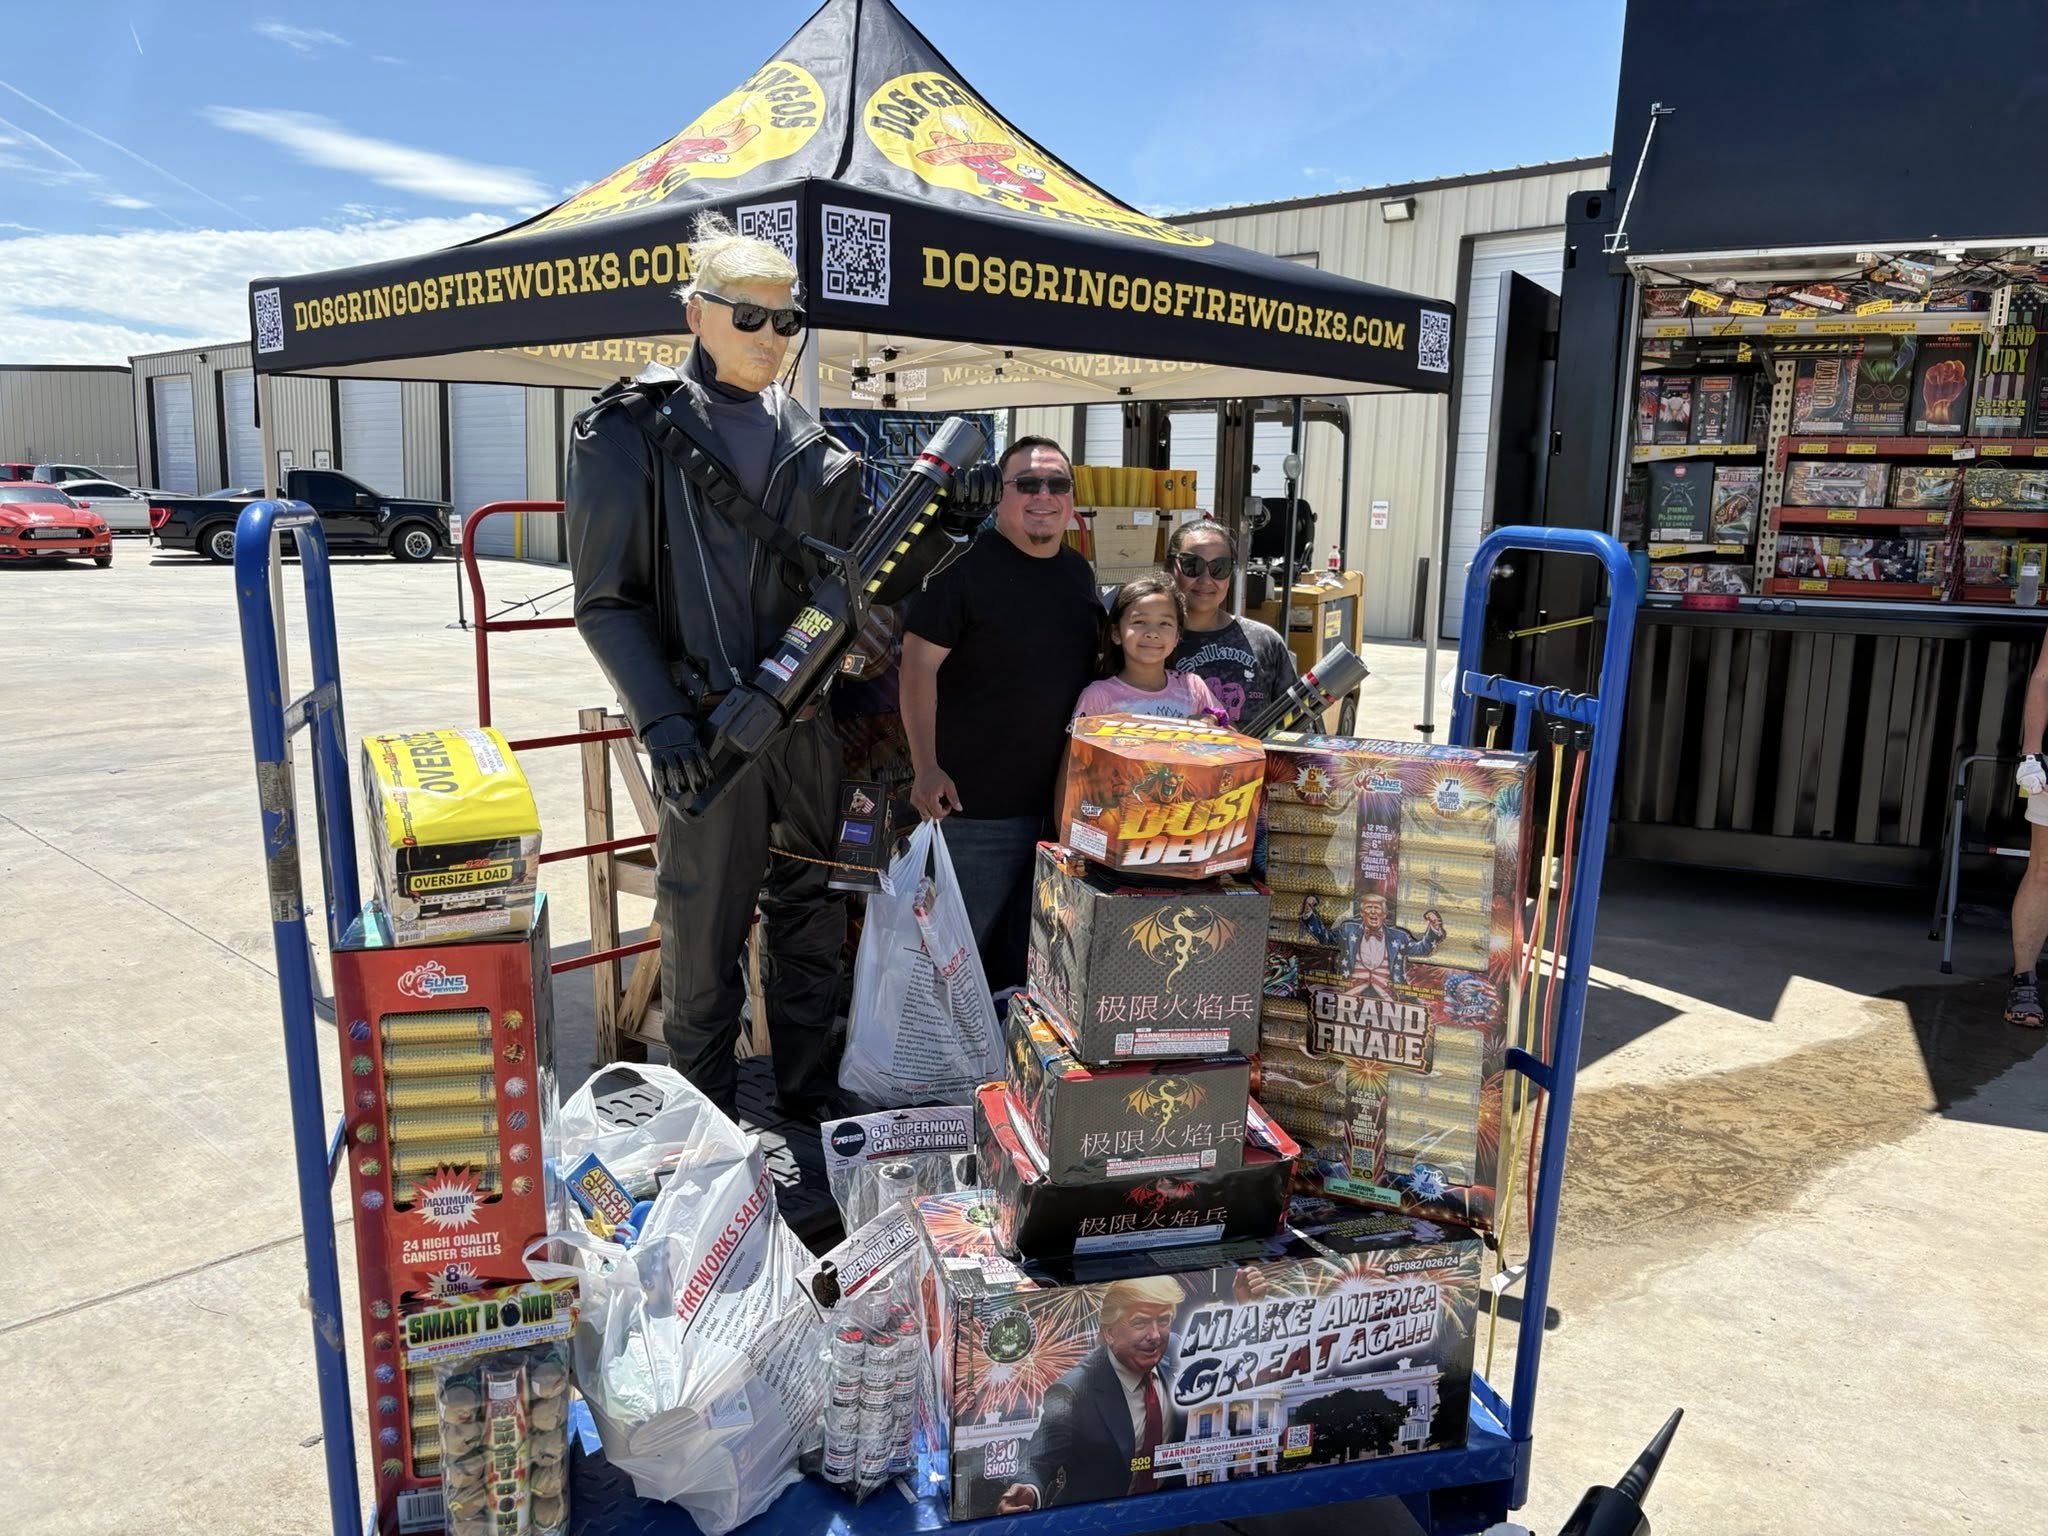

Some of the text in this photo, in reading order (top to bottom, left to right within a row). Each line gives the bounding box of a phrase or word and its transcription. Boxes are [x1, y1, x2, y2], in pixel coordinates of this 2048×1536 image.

[870, 87, 930, 142] DOS
[922, 246, 1407, 351] DOSGRINGOSFIREWORKS.COM
[1117, 777, 1264, 841] DUST
[1361, 831, 1393, 841] ASSORTED
[1375, 824, 1389, 833] PCS
[1121, 818, 1249, 867] DEVIL
[1361, 863, 1391, 873] CANISTER
[1363, 856, 1389, 865] QUALITY
[414, 868, 508, 889] OVERSIZE LOAD
[1364, 871, 1387, 880] SHELLS
[423, 976, 465, 988] SUNS
[1095, 992, 1254, 1025] 极限火焰兵
[1315, 991, 1427, 1036] GRAND
[1316, 1022, 1424, 1066] FINALE
[892, 1119, 966, 1136] SUPERNOVA
[1351, 1125, 1379, 1136] CANISTER
[1352, 1119, 1377, 1130] QUALITY
[872, 1132, 968, 1153] CANS SFX RING
[1079, 1119, 1244, 1157] 极限火焰兵
[588, 1167, 632, 1215] AIRCR
[1348, 1182, 1376, 1194] WARNING
[423, 1195, 475, 1209] MAXIMUM
[582, 1175, 623, 1223] CARRI
[433, 1204, 466, 1217] BLAST
[1078, 1206, 1228, 1237] 极限火焰兵
[402, 1232, 500, 1252] 24 HIGH QUALITY
[402, 1243, 502, 1265] CANISTER SHELLS
[837, 1241, 892, 1289] SUPERNOVA
[885, 1221, 917, 1251] CANS
[675, 1223, 740, 1322] FIREWORKS
[1386, 1255, 1459, 1274] 49F082/026/24
[441, 1282, 469, 1294] LONG
[408, 1304, 480, 1345] SMART
[1180, 1283, 1438, 1358] MAKE AMERICA
[1174, 1312, 1437, 1407] GREAT AGAIN
[1229, 1440, 1255, 1450] FLAMING
[985, 1460, 1017, 1477] SHOTS
[1130, 1464, 1151, 1472] GRAM
[1131, 1455, 1151, 1466] 500
